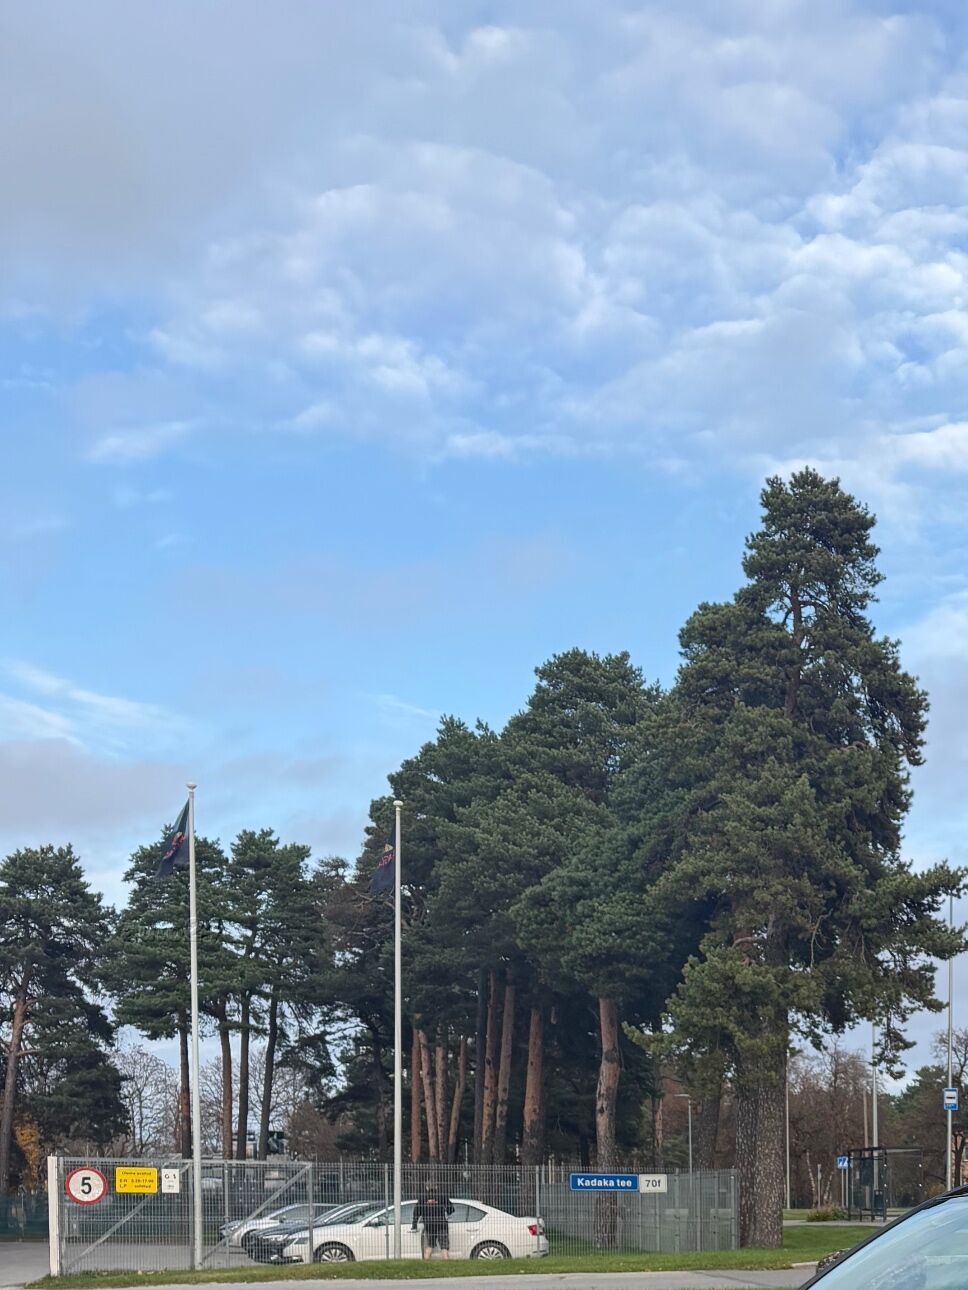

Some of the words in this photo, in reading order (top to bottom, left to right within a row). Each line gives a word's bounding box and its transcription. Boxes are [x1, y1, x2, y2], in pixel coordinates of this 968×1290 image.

[81, 1176, 92, 1195] 5
[577, 1177, 615, 1188] Kadaka
[617, 1178, 632, 1188] tee
